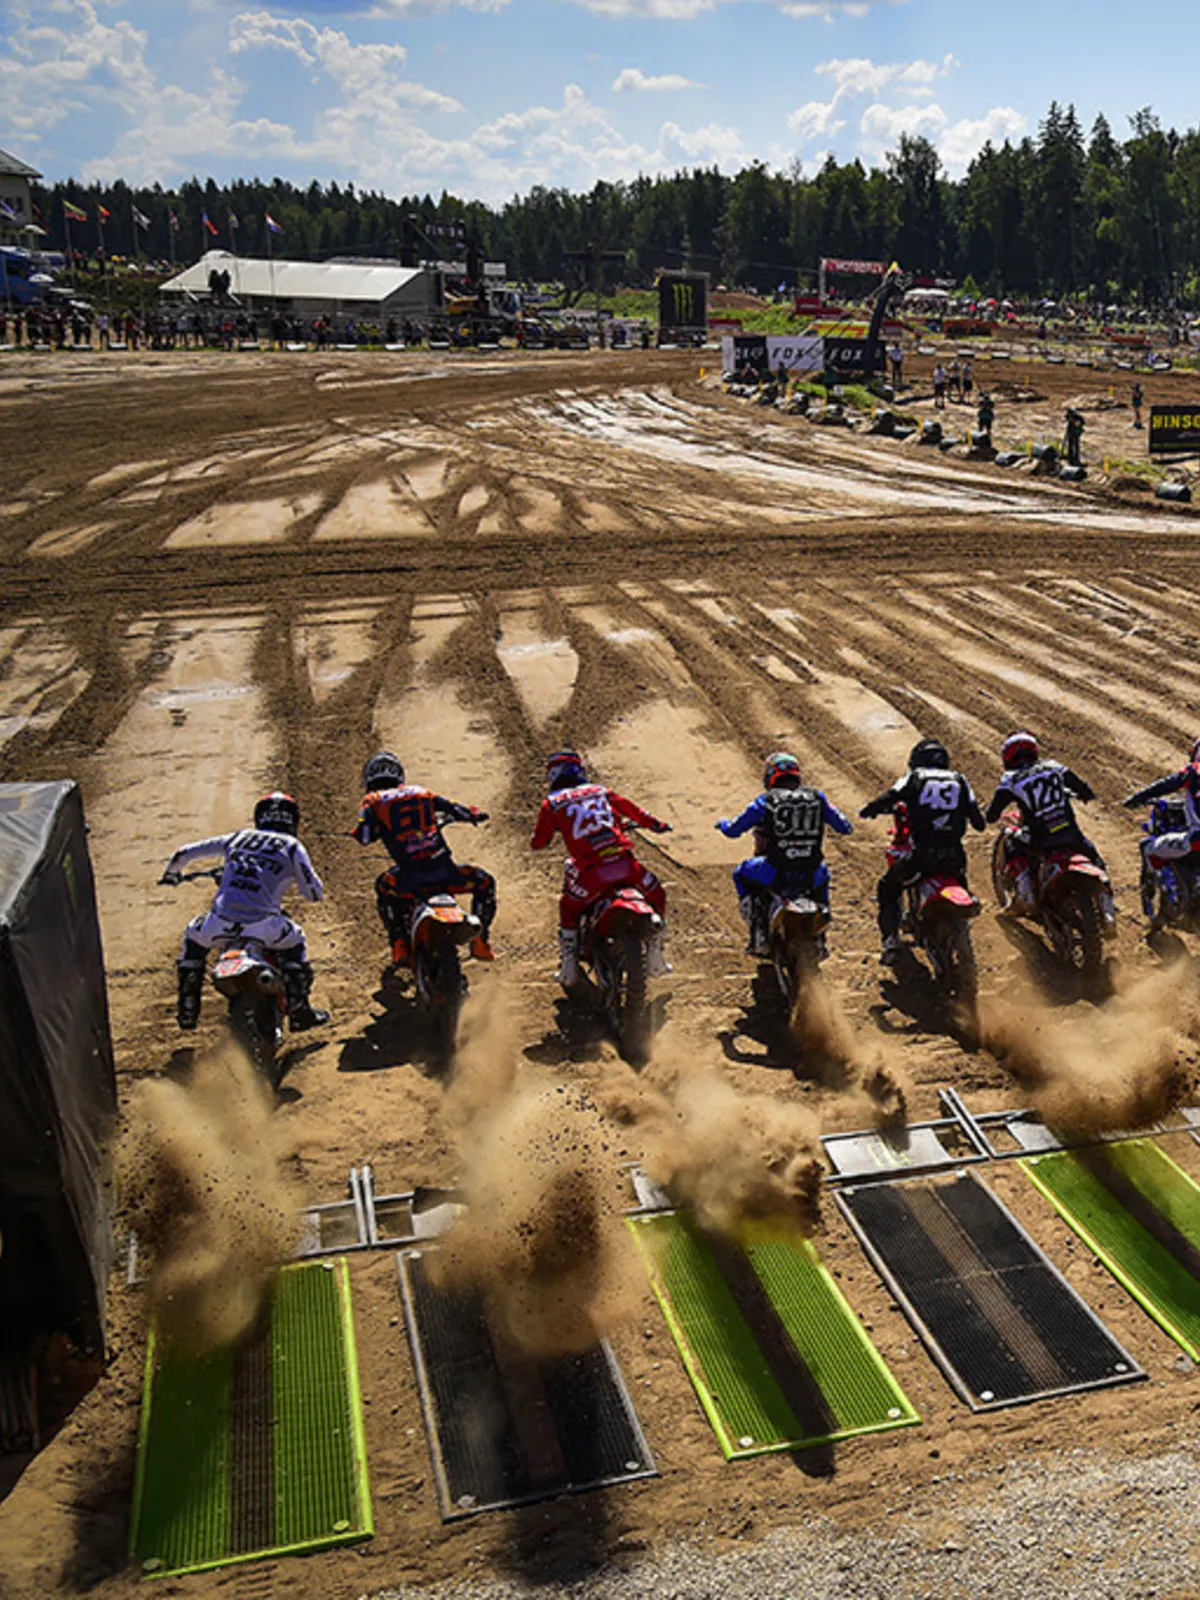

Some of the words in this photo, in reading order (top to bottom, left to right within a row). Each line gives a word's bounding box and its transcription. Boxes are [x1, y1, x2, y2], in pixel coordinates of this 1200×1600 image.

[829, 347, 863, 361] FOX
[919, 780, 961, 810] 43
[1022, 773, 1065, 812] 128
[391, 797, 431, 834] 61
[566, 797, 615, 840] 259
[772, 801, 821, 837] 911
